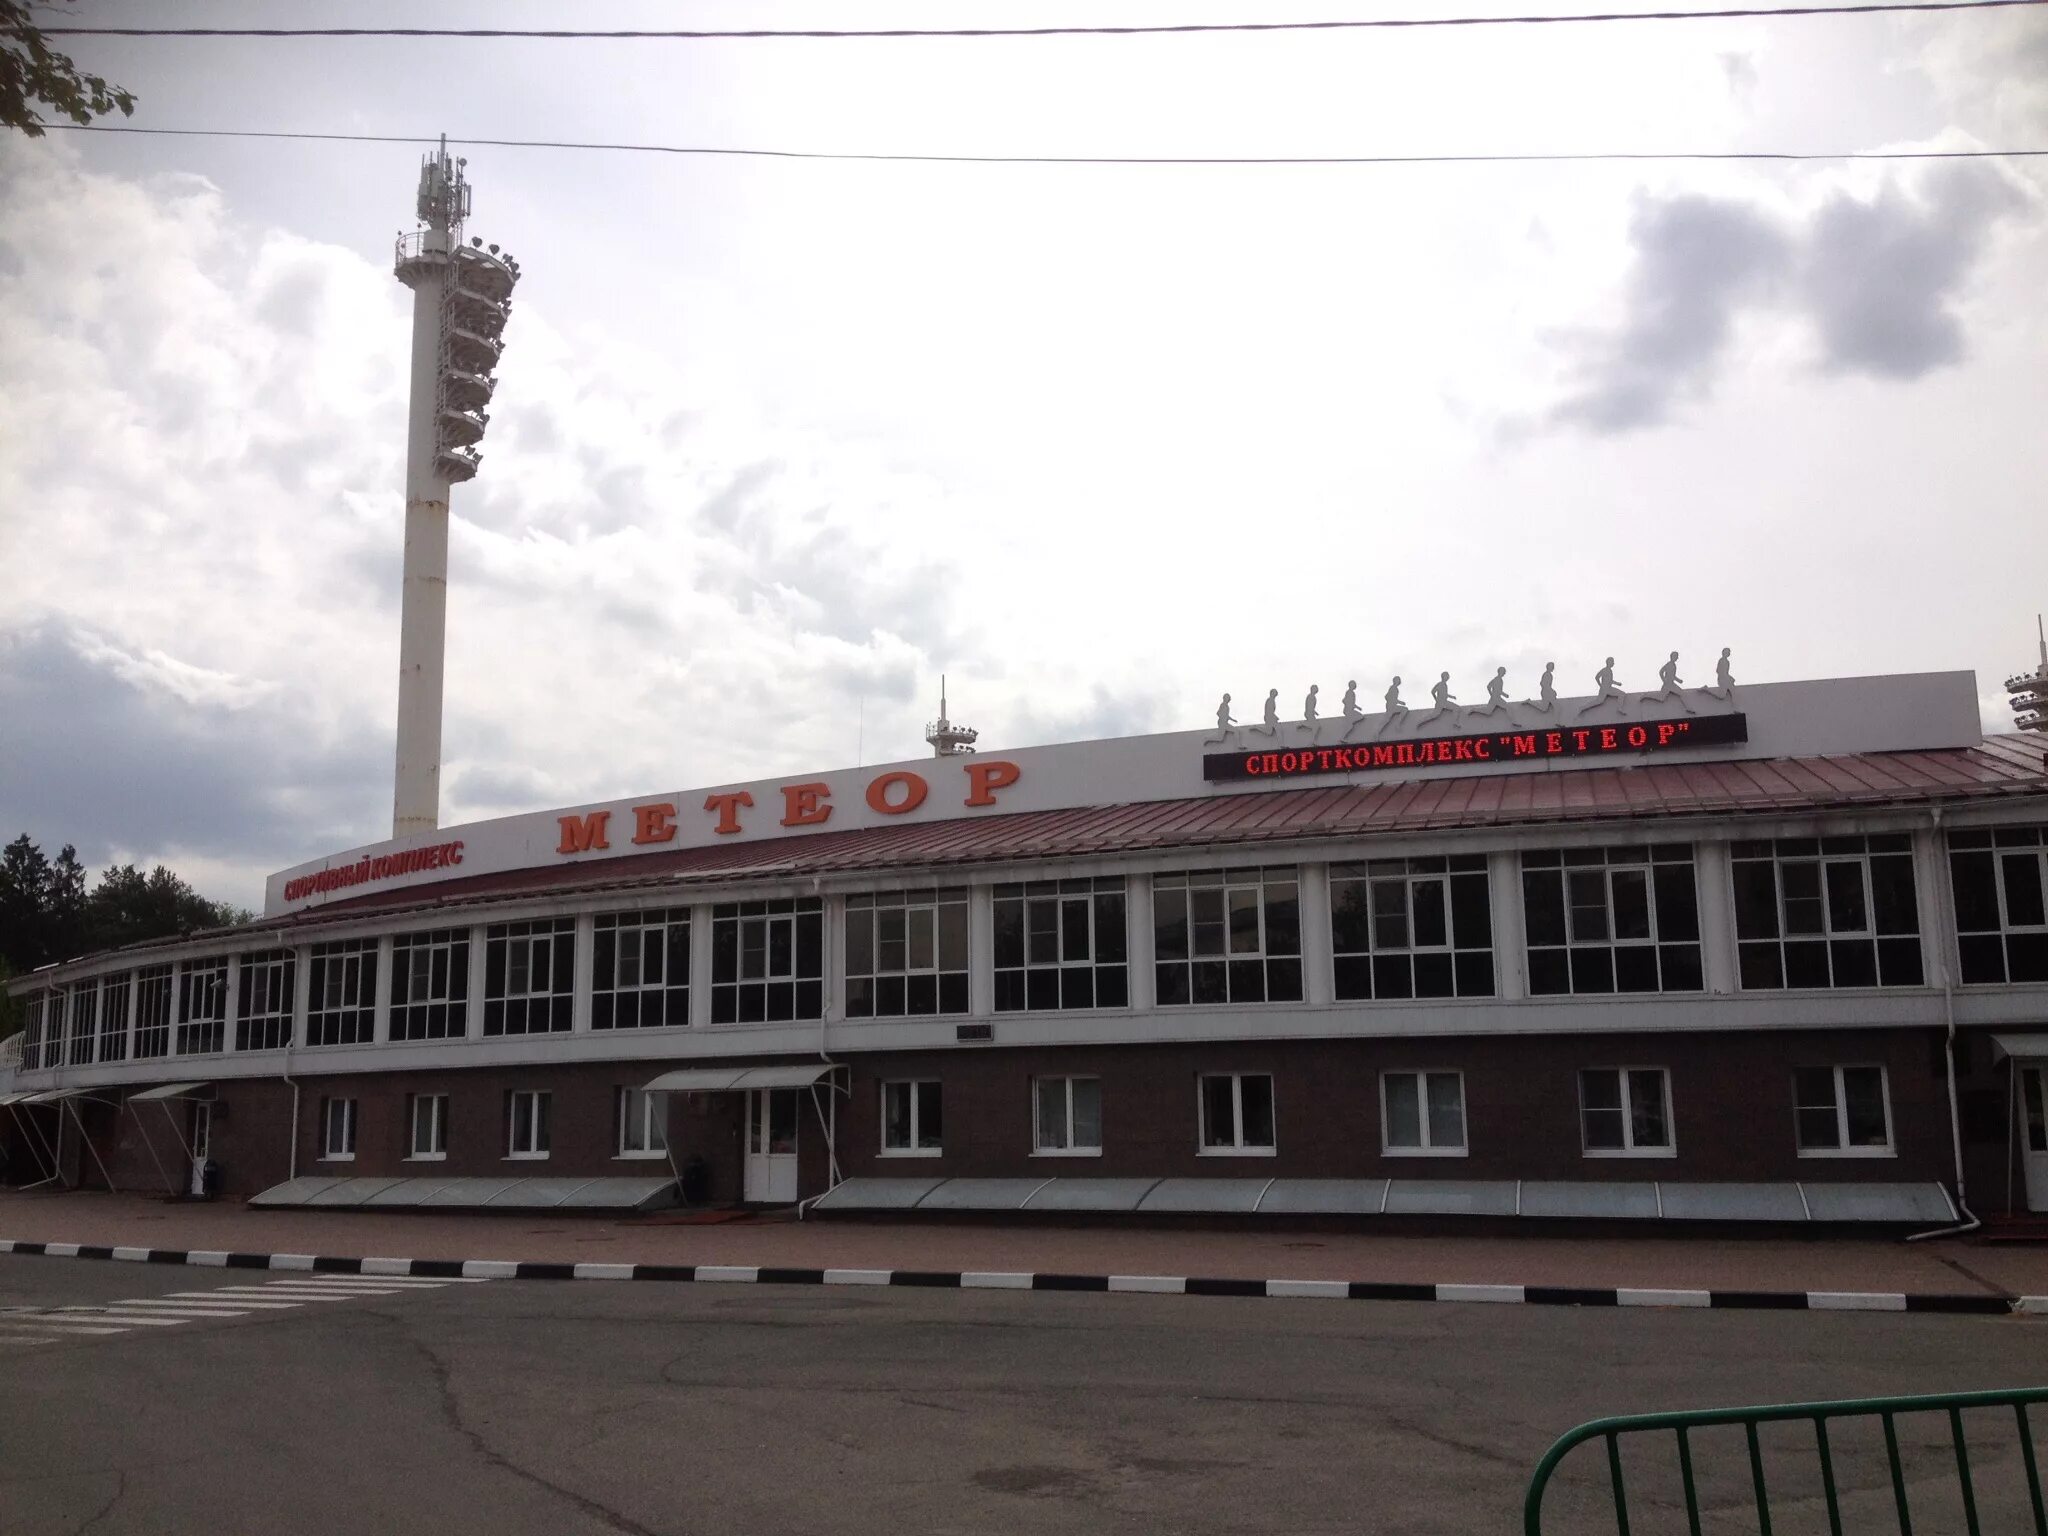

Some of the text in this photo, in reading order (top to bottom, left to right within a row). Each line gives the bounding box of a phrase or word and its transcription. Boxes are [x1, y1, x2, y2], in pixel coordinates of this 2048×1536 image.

[1245, 738, 1490, 774] СПОРТКОМПЛЕКС
[556, 761, 1020, 854] МЕТЕОР
[284, 840, 464, 901] СПОРТИВНЫЙ КОМПЛЕКС
